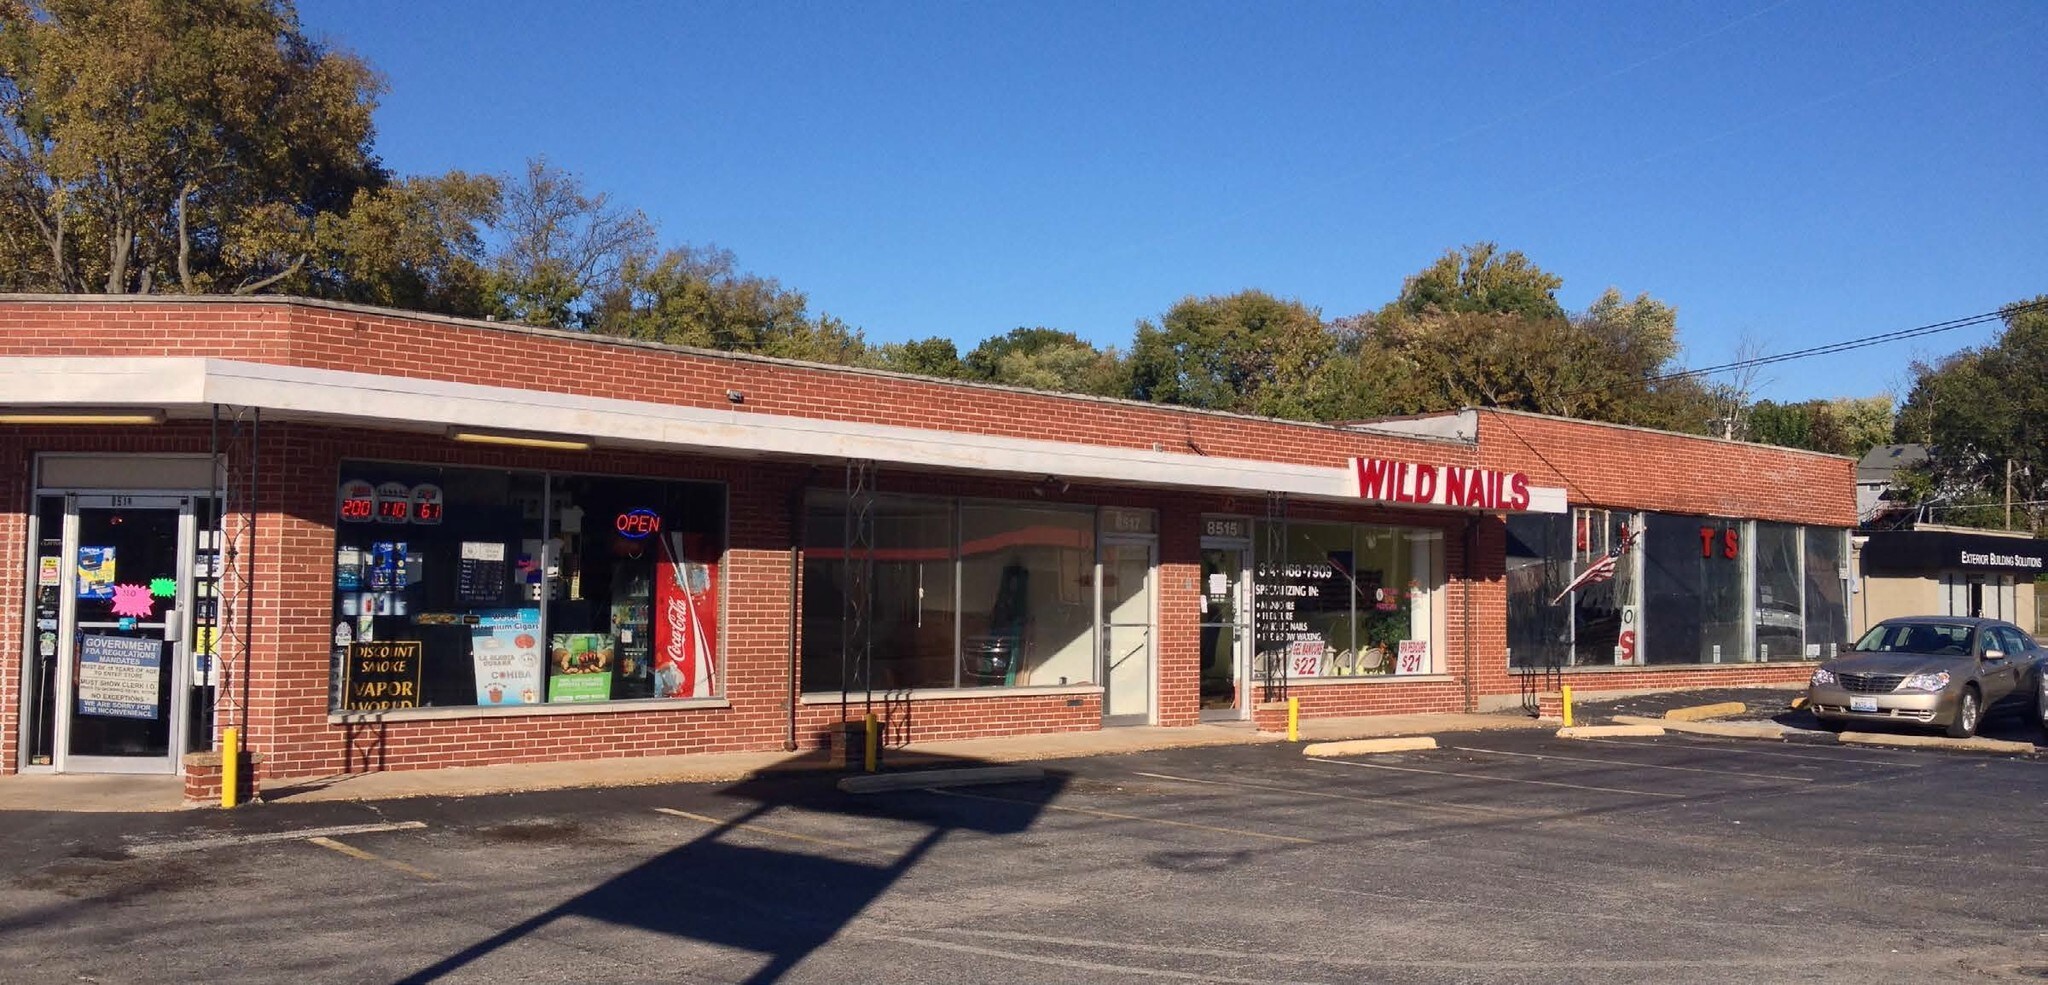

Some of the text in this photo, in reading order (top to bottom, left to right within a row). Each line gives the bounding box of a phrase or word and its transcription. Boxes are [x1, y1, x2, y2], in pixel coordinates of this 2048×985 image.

[1357, 457, 1530, 511] WILD NAILS
[342, 500, 371, 517] 200
[617, 514, 660, 532] OPEN
[1207, 521, 1238, 536] 8515
[1961, 551, 2042, 567] EXTERIOR BUILDING SOLUTIONS
[1290, 622, 1308, 631] NAILS
[1296, 632, 1322, 641] WAXING
[86, 638, 158, 652] GOVERNMENT
[99, 655, 140, 665] MANDATES
[102, 648, 156, 659] REGULATIONS
[361, 661, 407, 673] SMOKE
[1294, 657, 1316, 675] $22
[1402, 655, 1421, 672] $21
[354, 681, 414, 697] VAPOR
[98, 707, 153, 717] INCONVENIENCE
[112, 702, 135, 710] SORRY
